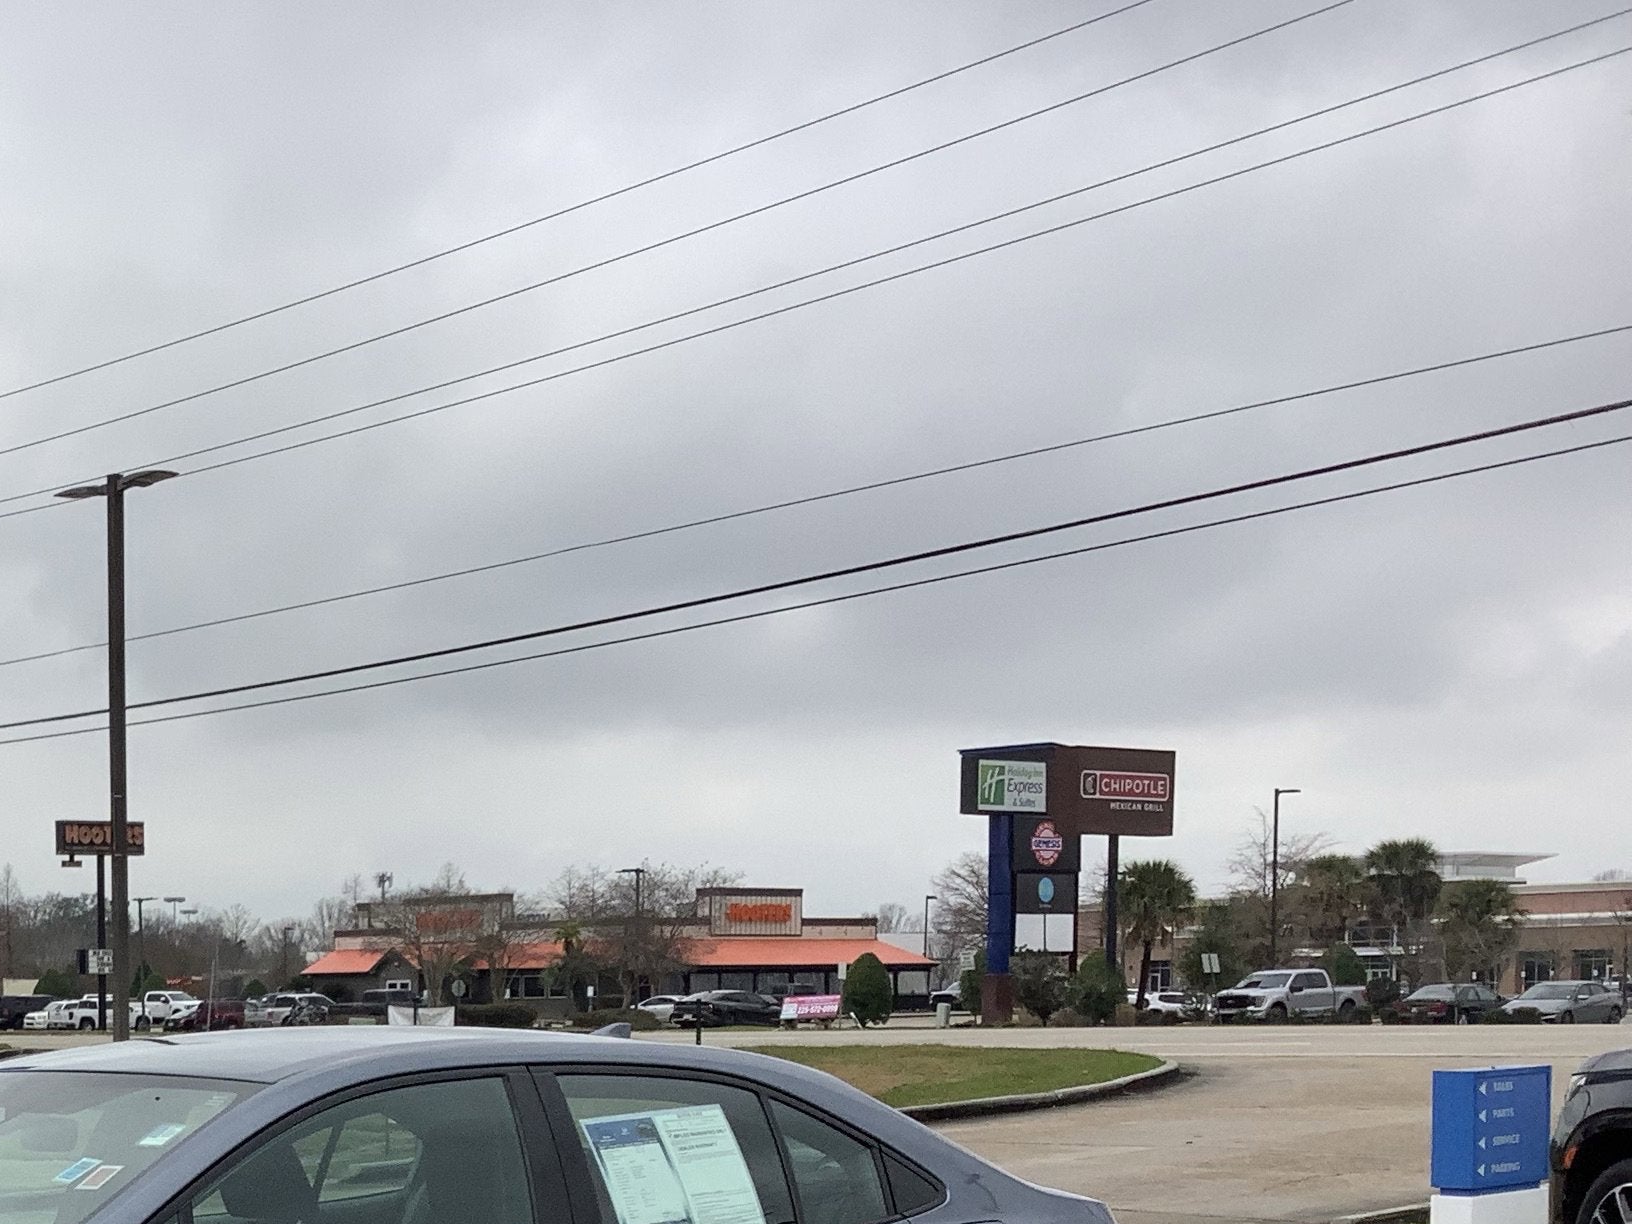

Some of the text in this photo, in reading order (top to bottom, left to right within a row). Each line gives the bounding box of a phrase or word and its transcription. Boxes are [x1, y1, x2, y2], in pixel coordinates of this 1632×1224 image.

[1007, 778, 1043, 796] Express
[1101, 778, 1165, 795] CHIPOTLE
[1110, 801, 1163, 812] MEXICAN GRILL
[65, 824, 143, 844] HOOTRS
[1033, 839, 1061, 849] GENESIS
